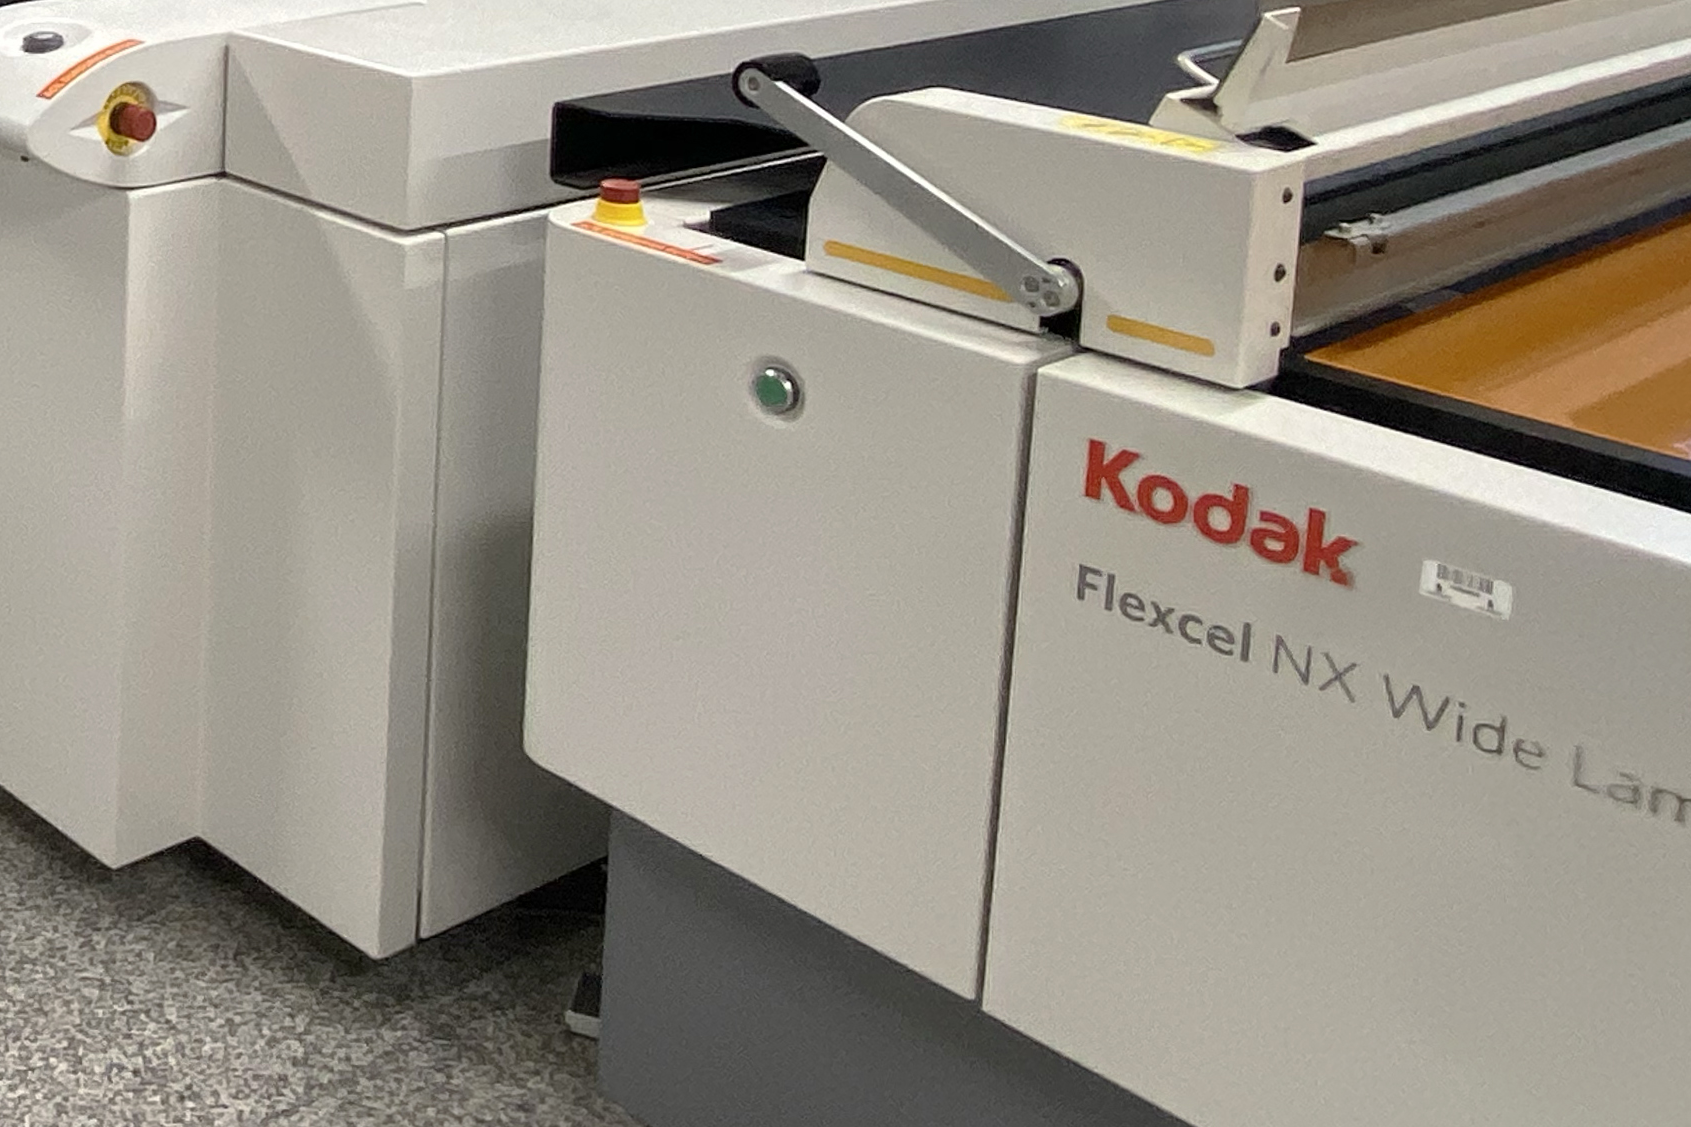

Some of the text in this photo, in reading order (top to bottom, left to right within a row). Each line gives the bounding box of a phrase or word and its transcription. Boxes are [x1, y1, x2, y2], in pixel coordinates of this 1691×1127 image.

[1084, 438, 1363, 588] Kodak
[1076, 563, 1253, 664] Flexcel
[1272, 634, 1358, 703] NX
[1382, 673, 1547, 772] Wide
